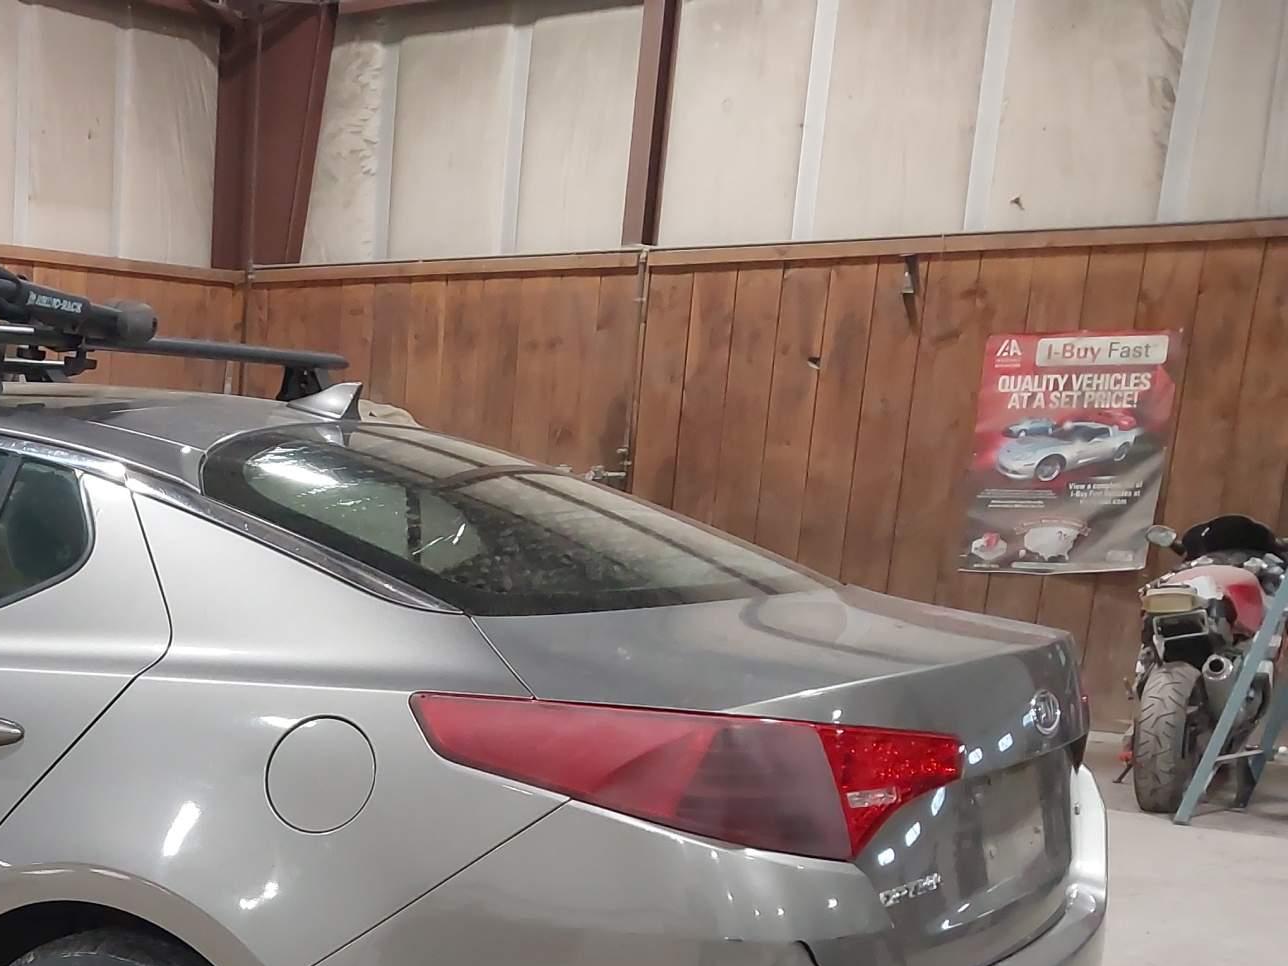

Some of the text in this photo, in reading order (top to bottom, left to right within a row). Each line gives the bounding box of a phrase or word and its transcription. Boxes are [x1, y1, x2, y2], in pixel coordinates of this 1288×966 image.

[1047, 341, 1152, 362] I-Buy Fast
[998, 372, 1152, 393] QUALITY VEHICLES
[1007, 390, 1140, 409] AT A SET PRICE!
